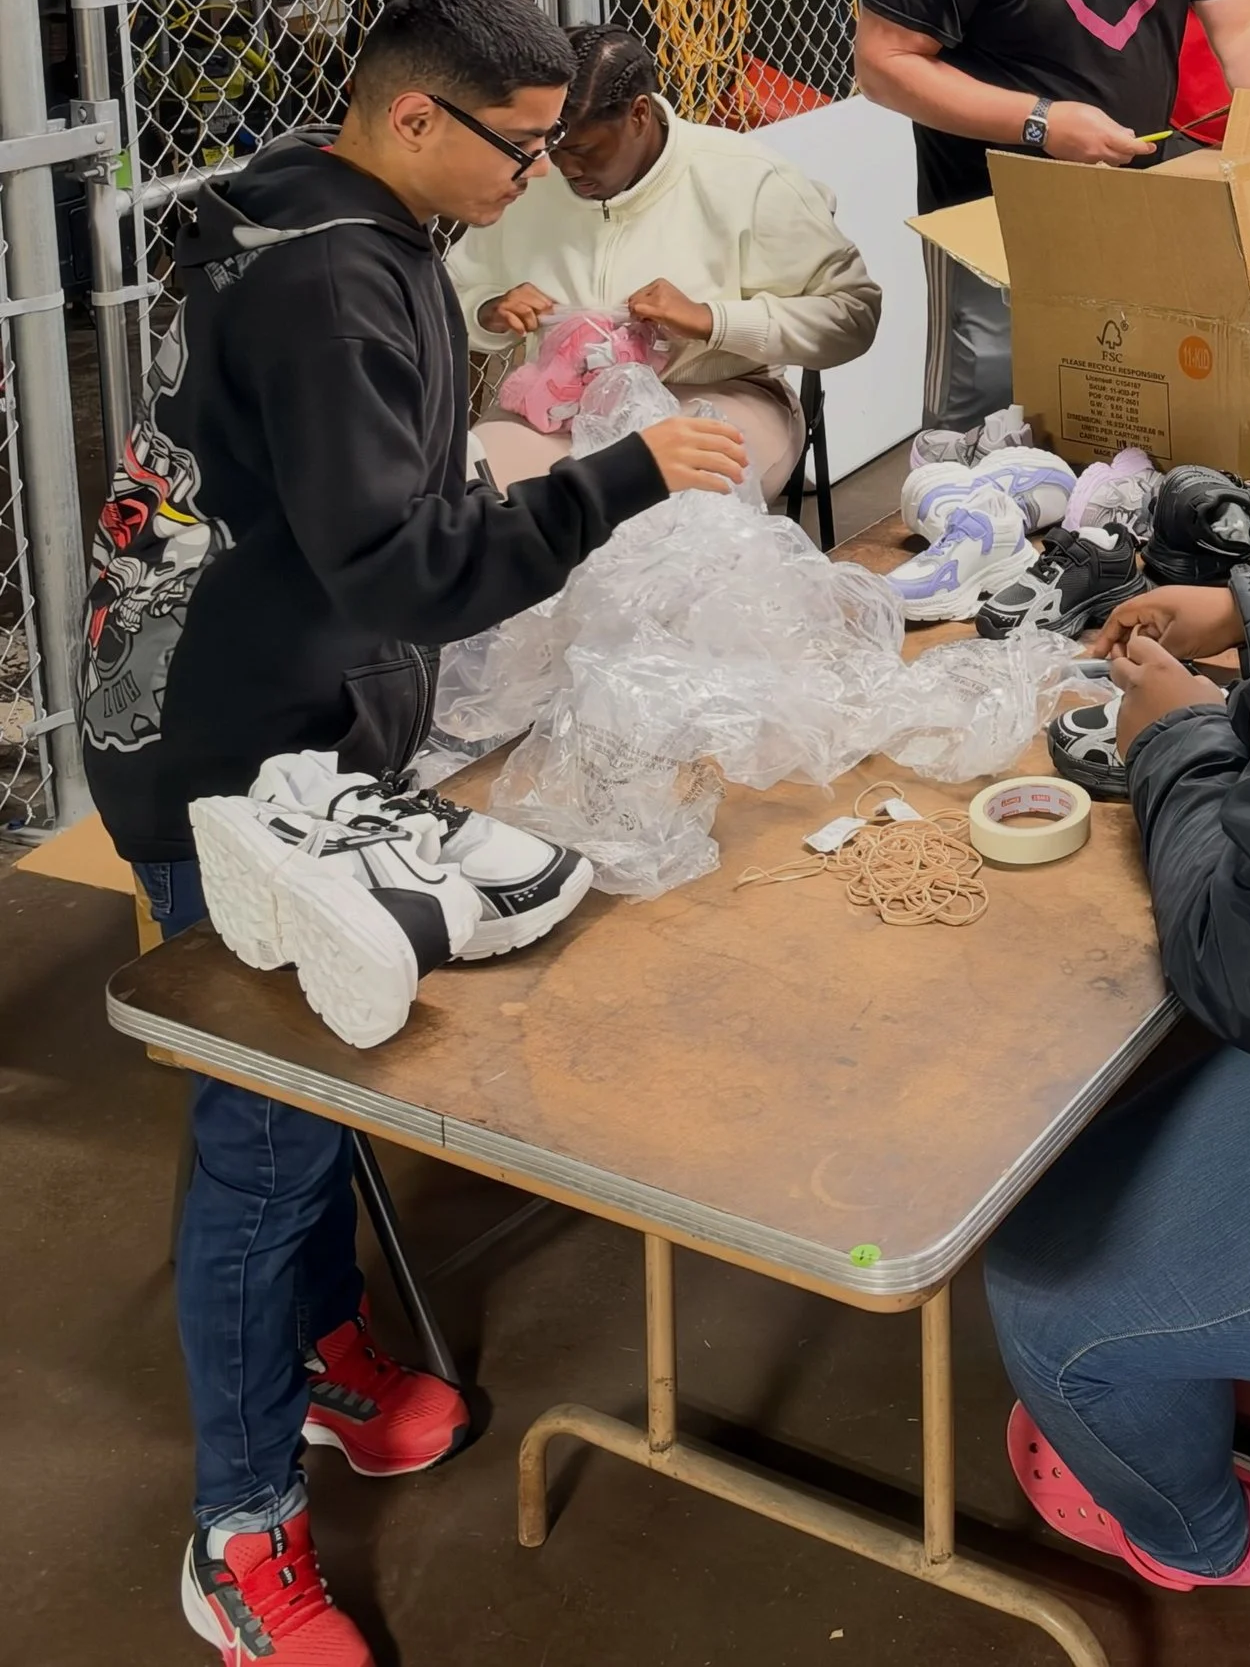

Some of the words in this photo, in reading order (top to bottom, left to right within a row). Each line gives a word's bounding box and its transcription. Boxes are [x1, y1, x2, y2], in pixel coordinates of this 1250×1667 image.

[1101, 350, 1123, 364] FSC
[1061, 357, 1086, 369] PLEASE
[1087, 361, 1116, 373] RECYCLE
[1118, 366, 1166, 381] RESPONSIBLY
[1125, 405, 1139, 415] LBS
[1126, 414, 1139, 423] LBS
[1081, 423, 1099, 434] UNITS
[1099, 426, 1113, 437] PER
